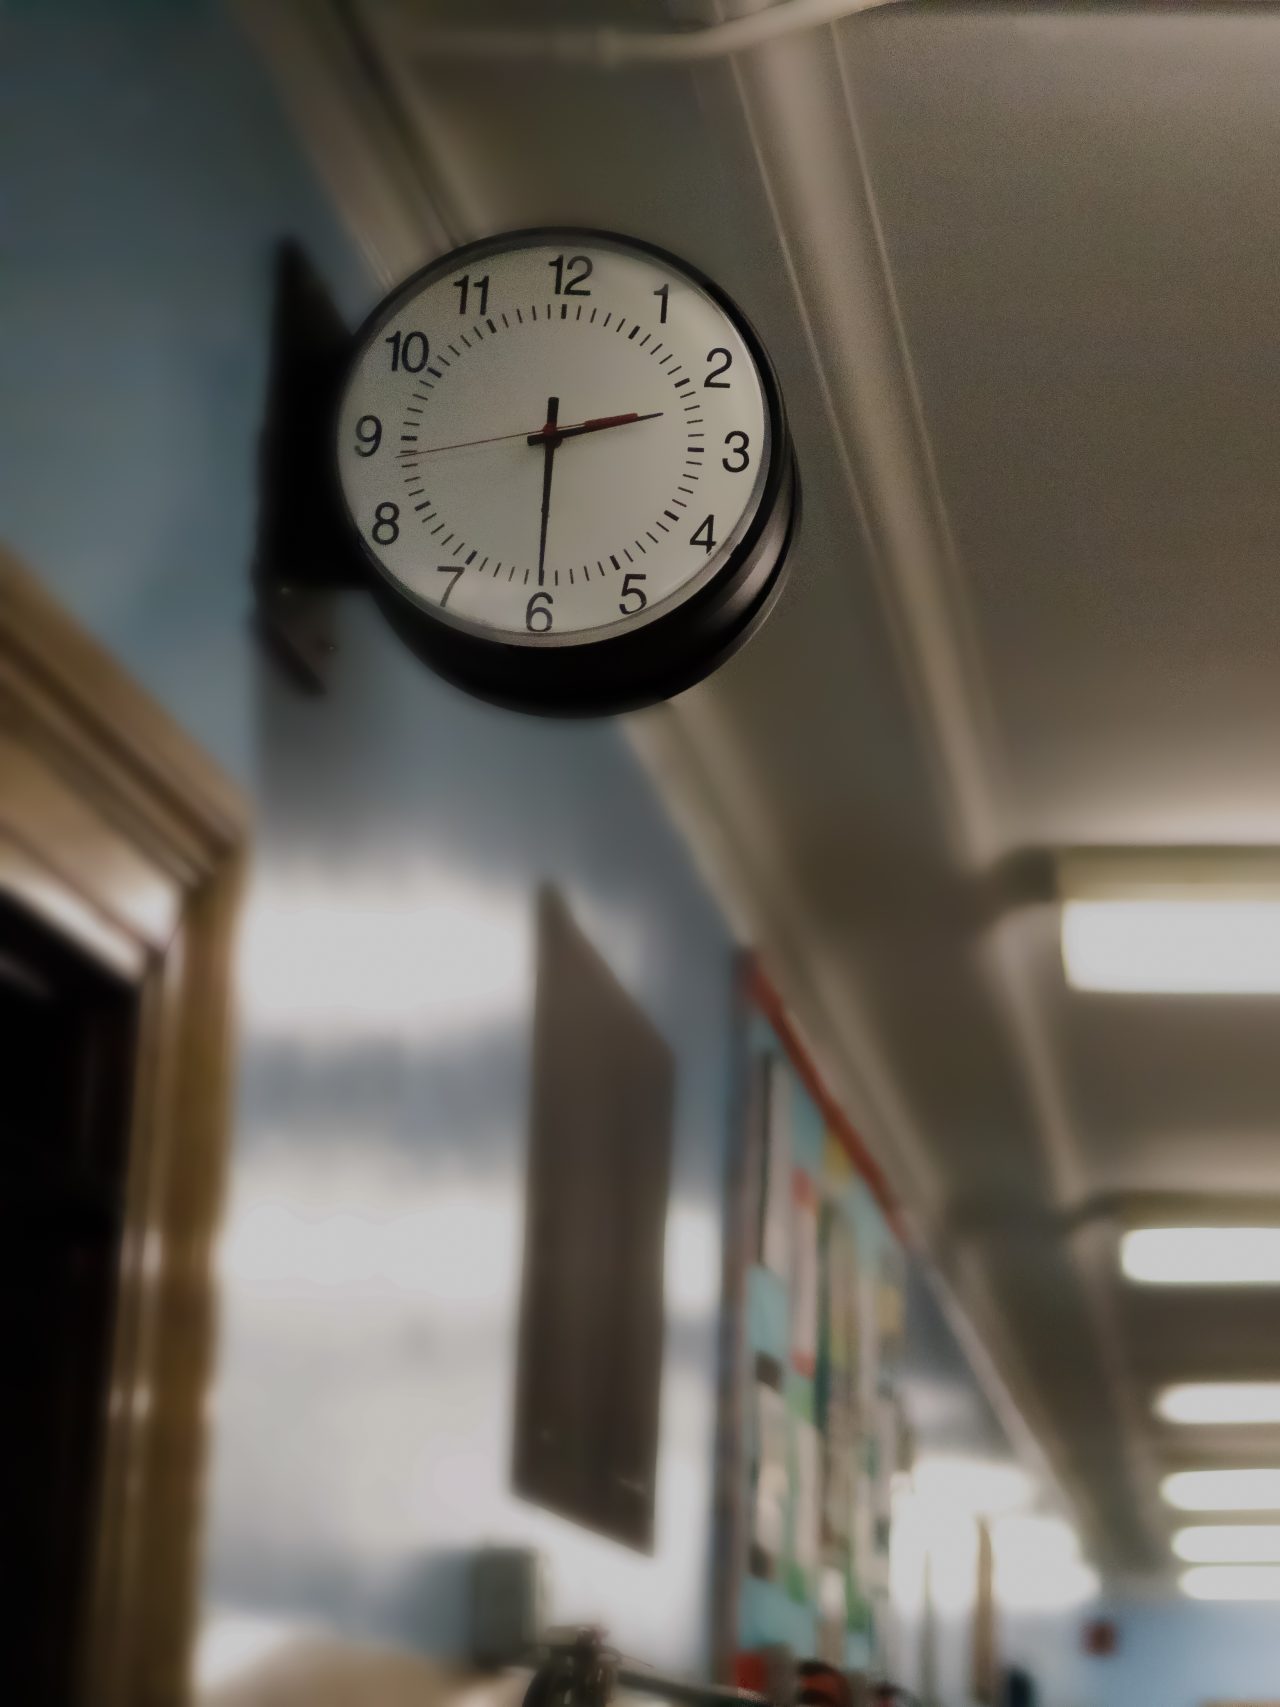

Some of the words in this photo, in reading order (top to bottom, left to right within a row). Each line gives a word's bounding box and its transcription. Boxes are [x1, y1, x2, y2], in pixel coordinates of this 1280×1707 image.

[453, 274, 491, 316] 11
[548, 254, 594, 297] 12
[652, 283, 671, 324] 1
[385, 330, 430, 373] 10
[703, 347, 734, 389] 2
[353, 414, 383, 458] 9
[721, 430, 751, 473] 3
[371, 501, 401, 546] 8
[689, 514, 718, 555] 4
[436, 565, 466, 608] 7
[618, 573, 648, 616] 5
[525, 591, 554, 633] 6
